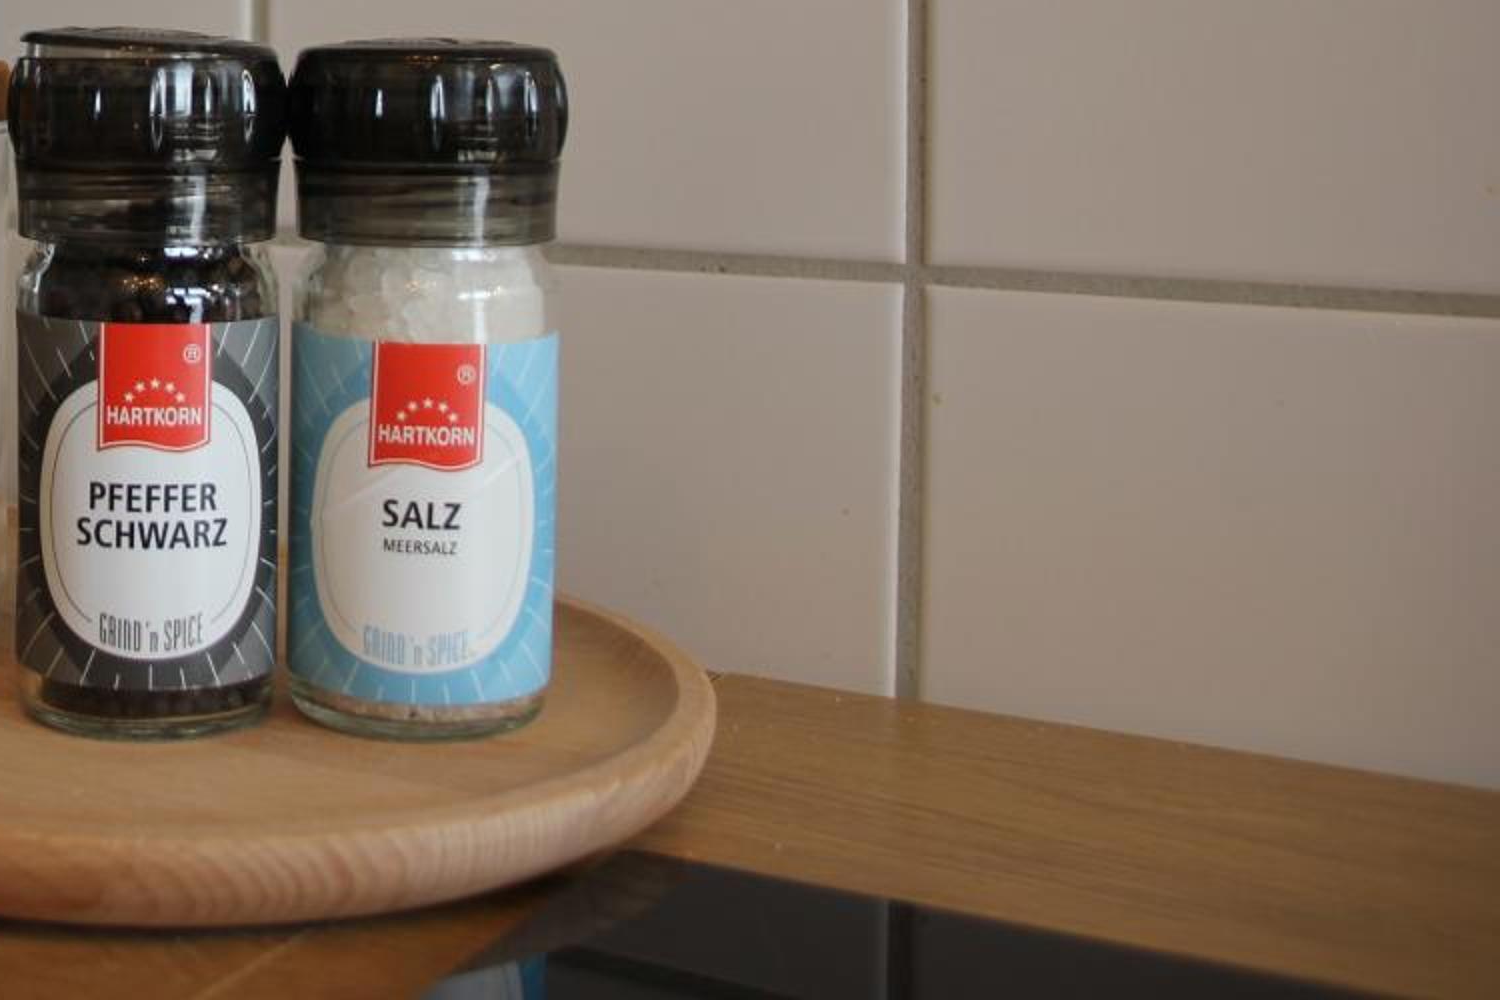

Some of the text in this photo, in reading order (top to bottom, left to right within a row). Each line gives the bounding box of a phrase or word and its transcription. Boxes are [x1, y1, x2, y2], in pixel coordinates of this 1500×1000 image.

[107, 404, 202, 426] HARTKORN
[378, 424, 476, 447] HARTKORN
[88, 480, 218, 513] PFEFFER
[381, 498, 462, 531] SALZ
[76, 516, 228, 550] SCHWARZ
[382, 538, 458, 556] MEERSALZ
[163, 611, 203, 652] SPICE
